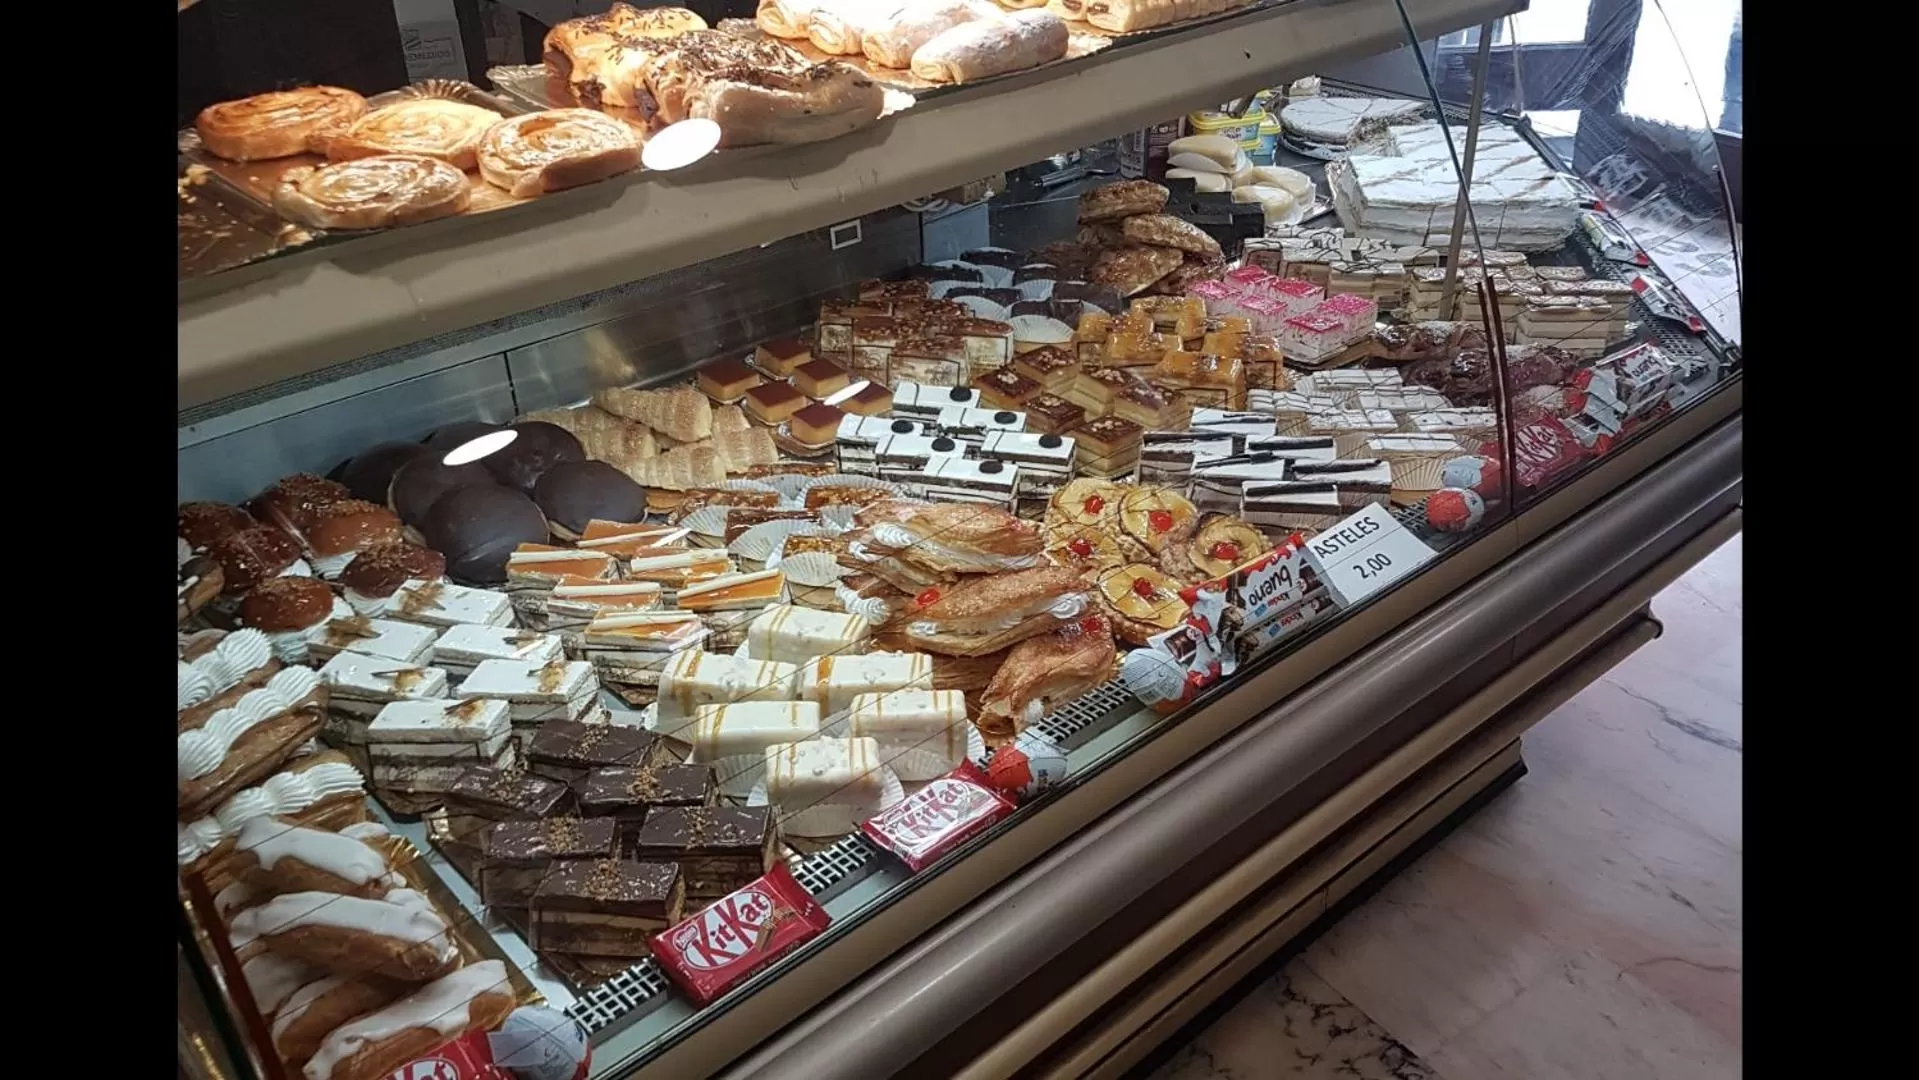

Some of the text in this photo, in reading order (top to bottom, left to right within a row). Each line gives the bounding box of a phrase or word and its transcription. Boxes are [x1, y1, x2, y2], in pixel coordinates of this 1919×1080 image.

[1313, 516, 1380, 559] ASTELES
[1249, 564, 1293, 606] bueno
[1353, 552, 1392, 580] 2,00
[898, 781, 964, 839] KitKat
[696, 892, 769, 968] KitKat
